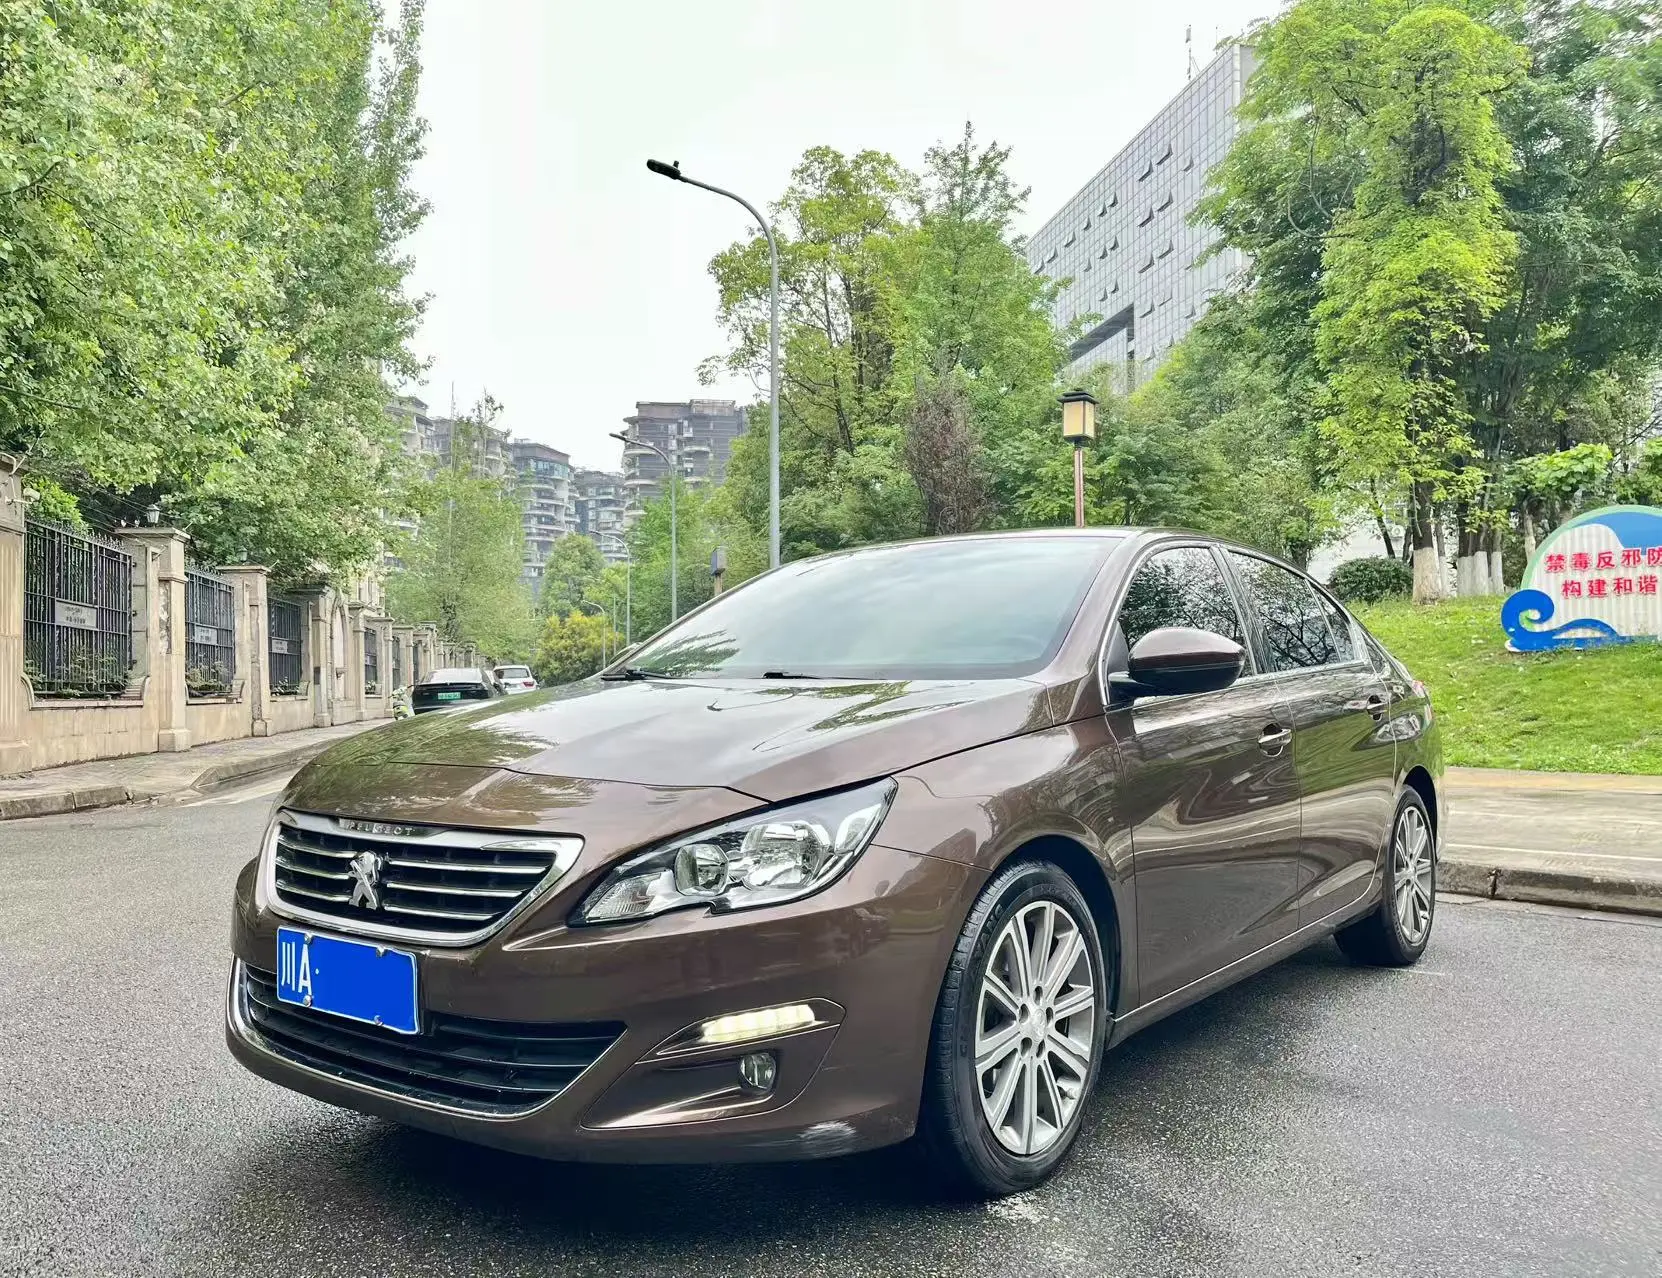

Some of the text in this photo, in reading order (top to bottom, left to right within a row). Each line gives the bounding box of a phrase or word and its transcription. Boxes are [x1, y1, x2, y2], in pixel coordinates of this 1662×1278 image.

[1545, 548, 1662, 572] 禁毒反邪防
[1562, 575, 1658, 597] 构建和谐
